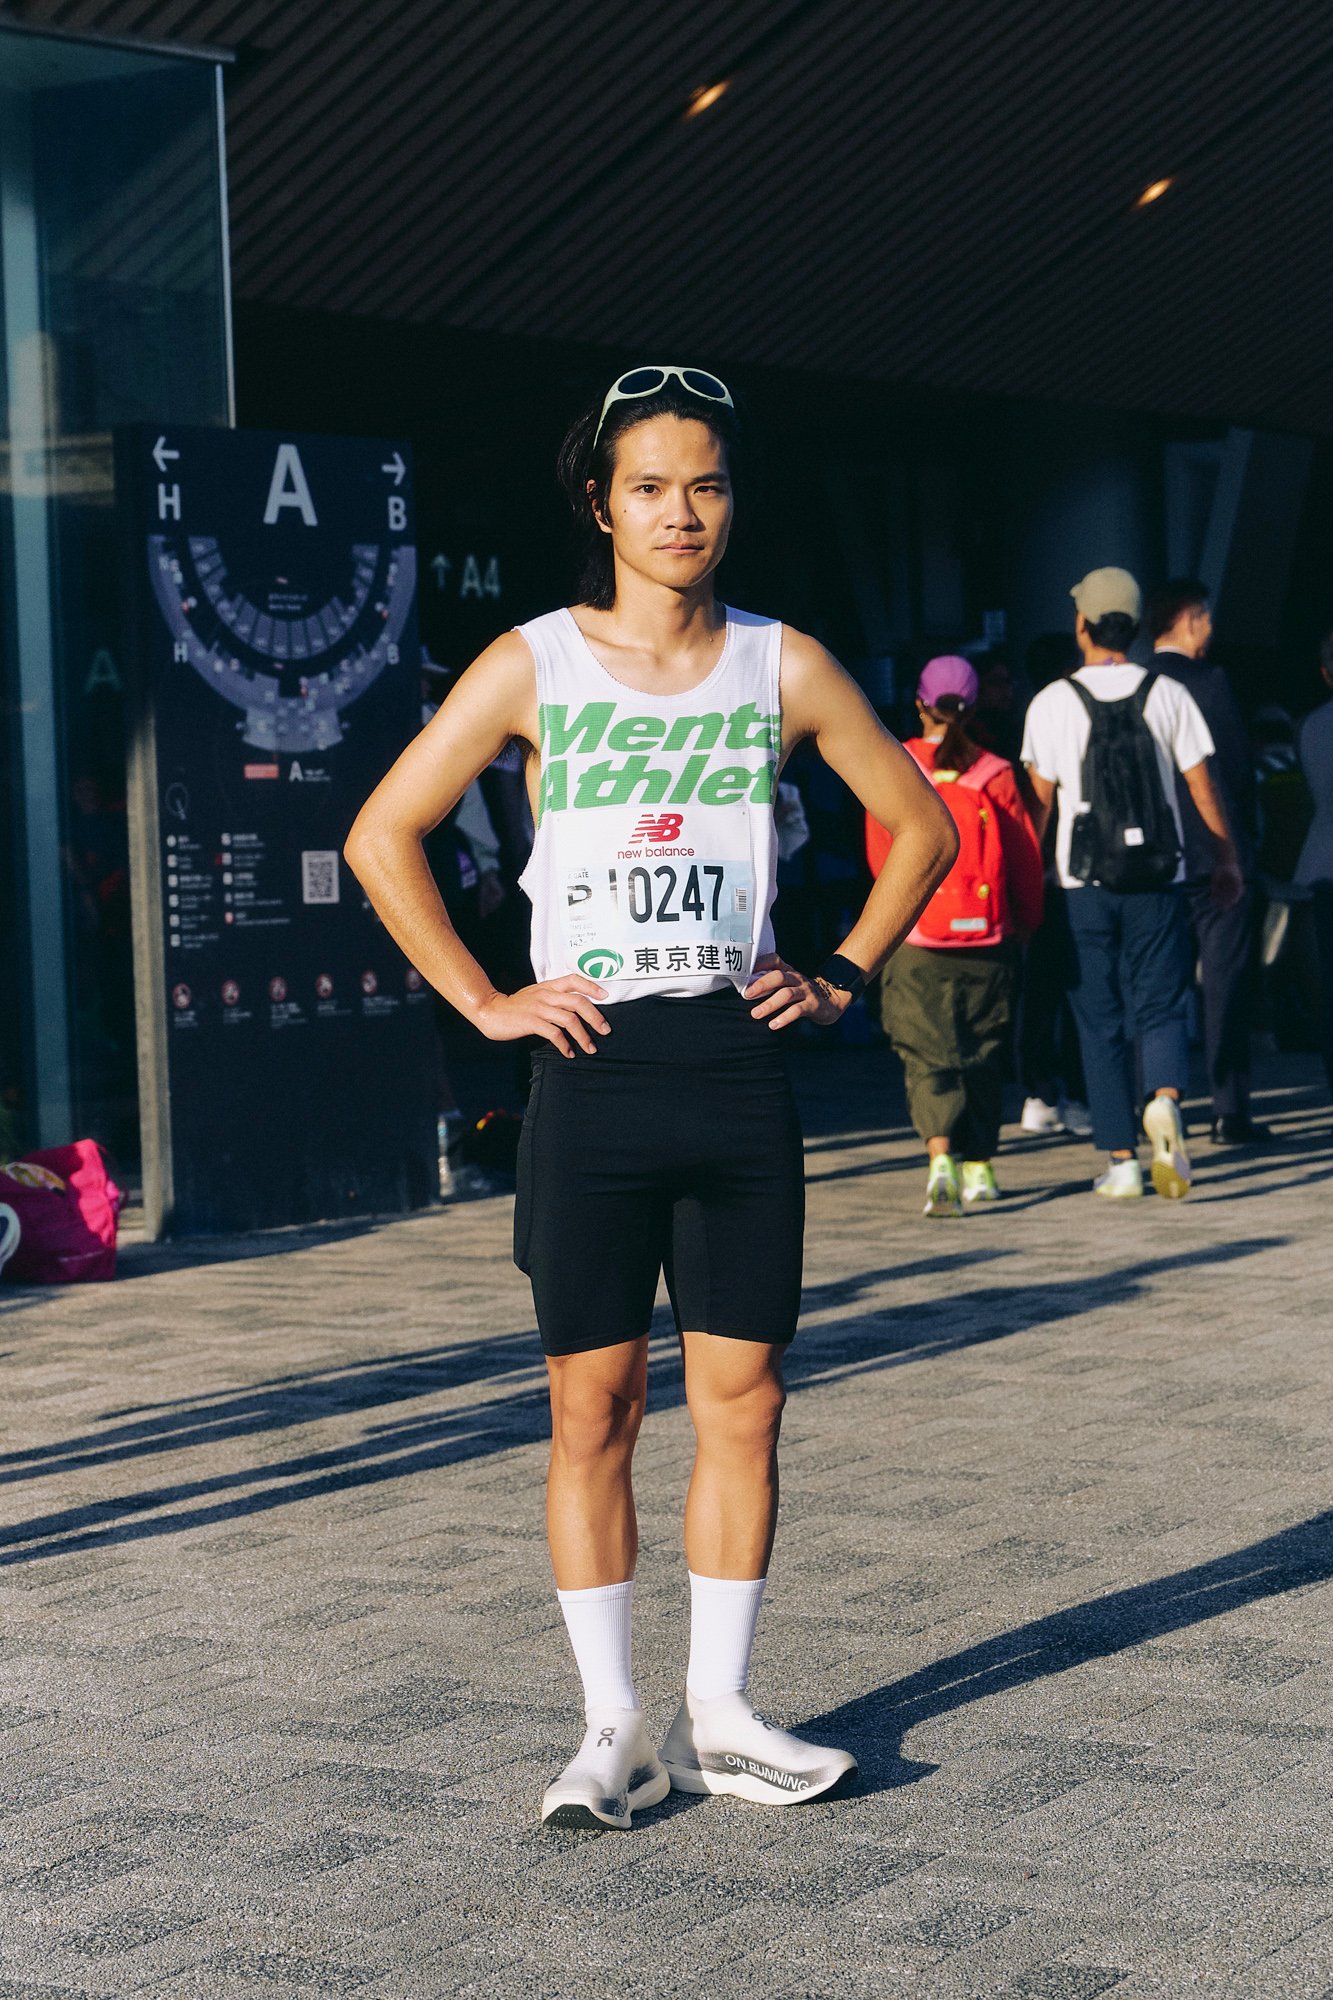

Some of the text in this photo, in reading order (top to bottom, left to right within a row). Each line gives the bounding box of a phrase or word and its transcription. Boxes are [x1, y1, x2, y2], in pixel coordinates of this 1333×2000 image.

[158, 483, 181, 521] H
[263, 444, 318, 527] A
[388, 496, 407, 531] B
[461, 555, 501, 599] A4
[174, 640, 188, 663] H
[289, 760, 304, 781] A
[617, 846, 695, 859] new balance
[634, 945, 743, 974] 東京建物
[725, 1754, 810, 1792] ON RUNNING
